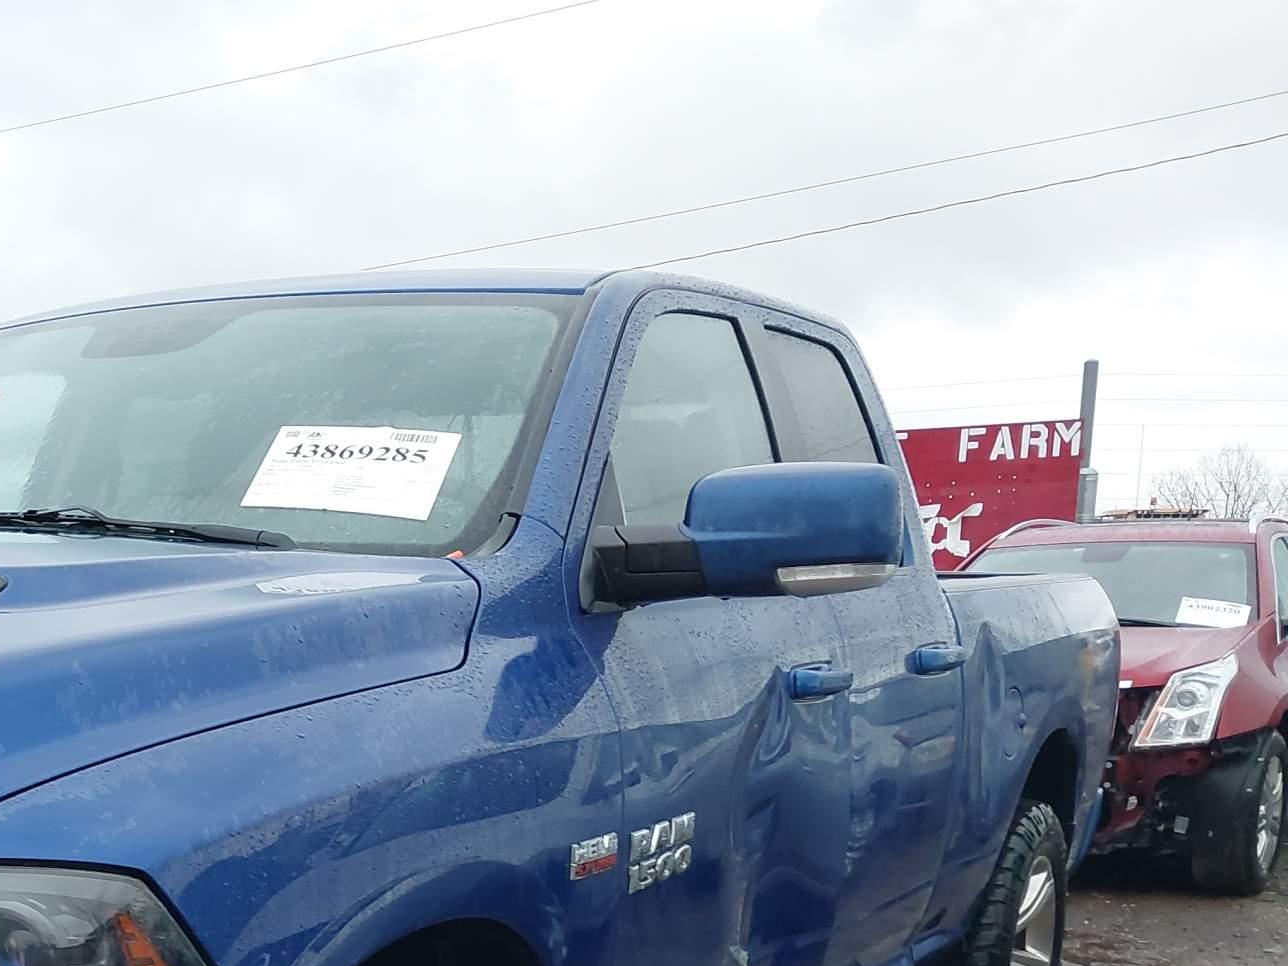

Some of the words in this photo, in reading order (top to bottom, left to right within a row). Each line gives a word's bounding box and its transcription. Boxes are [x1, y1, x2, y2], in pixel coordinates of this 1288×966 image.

[285, 442, 430, 465] 43869285
[958, 421, 1082, 463] FARM
[629, 811, 697, 863] RAM
[628, 843, 693, 895] 1500
